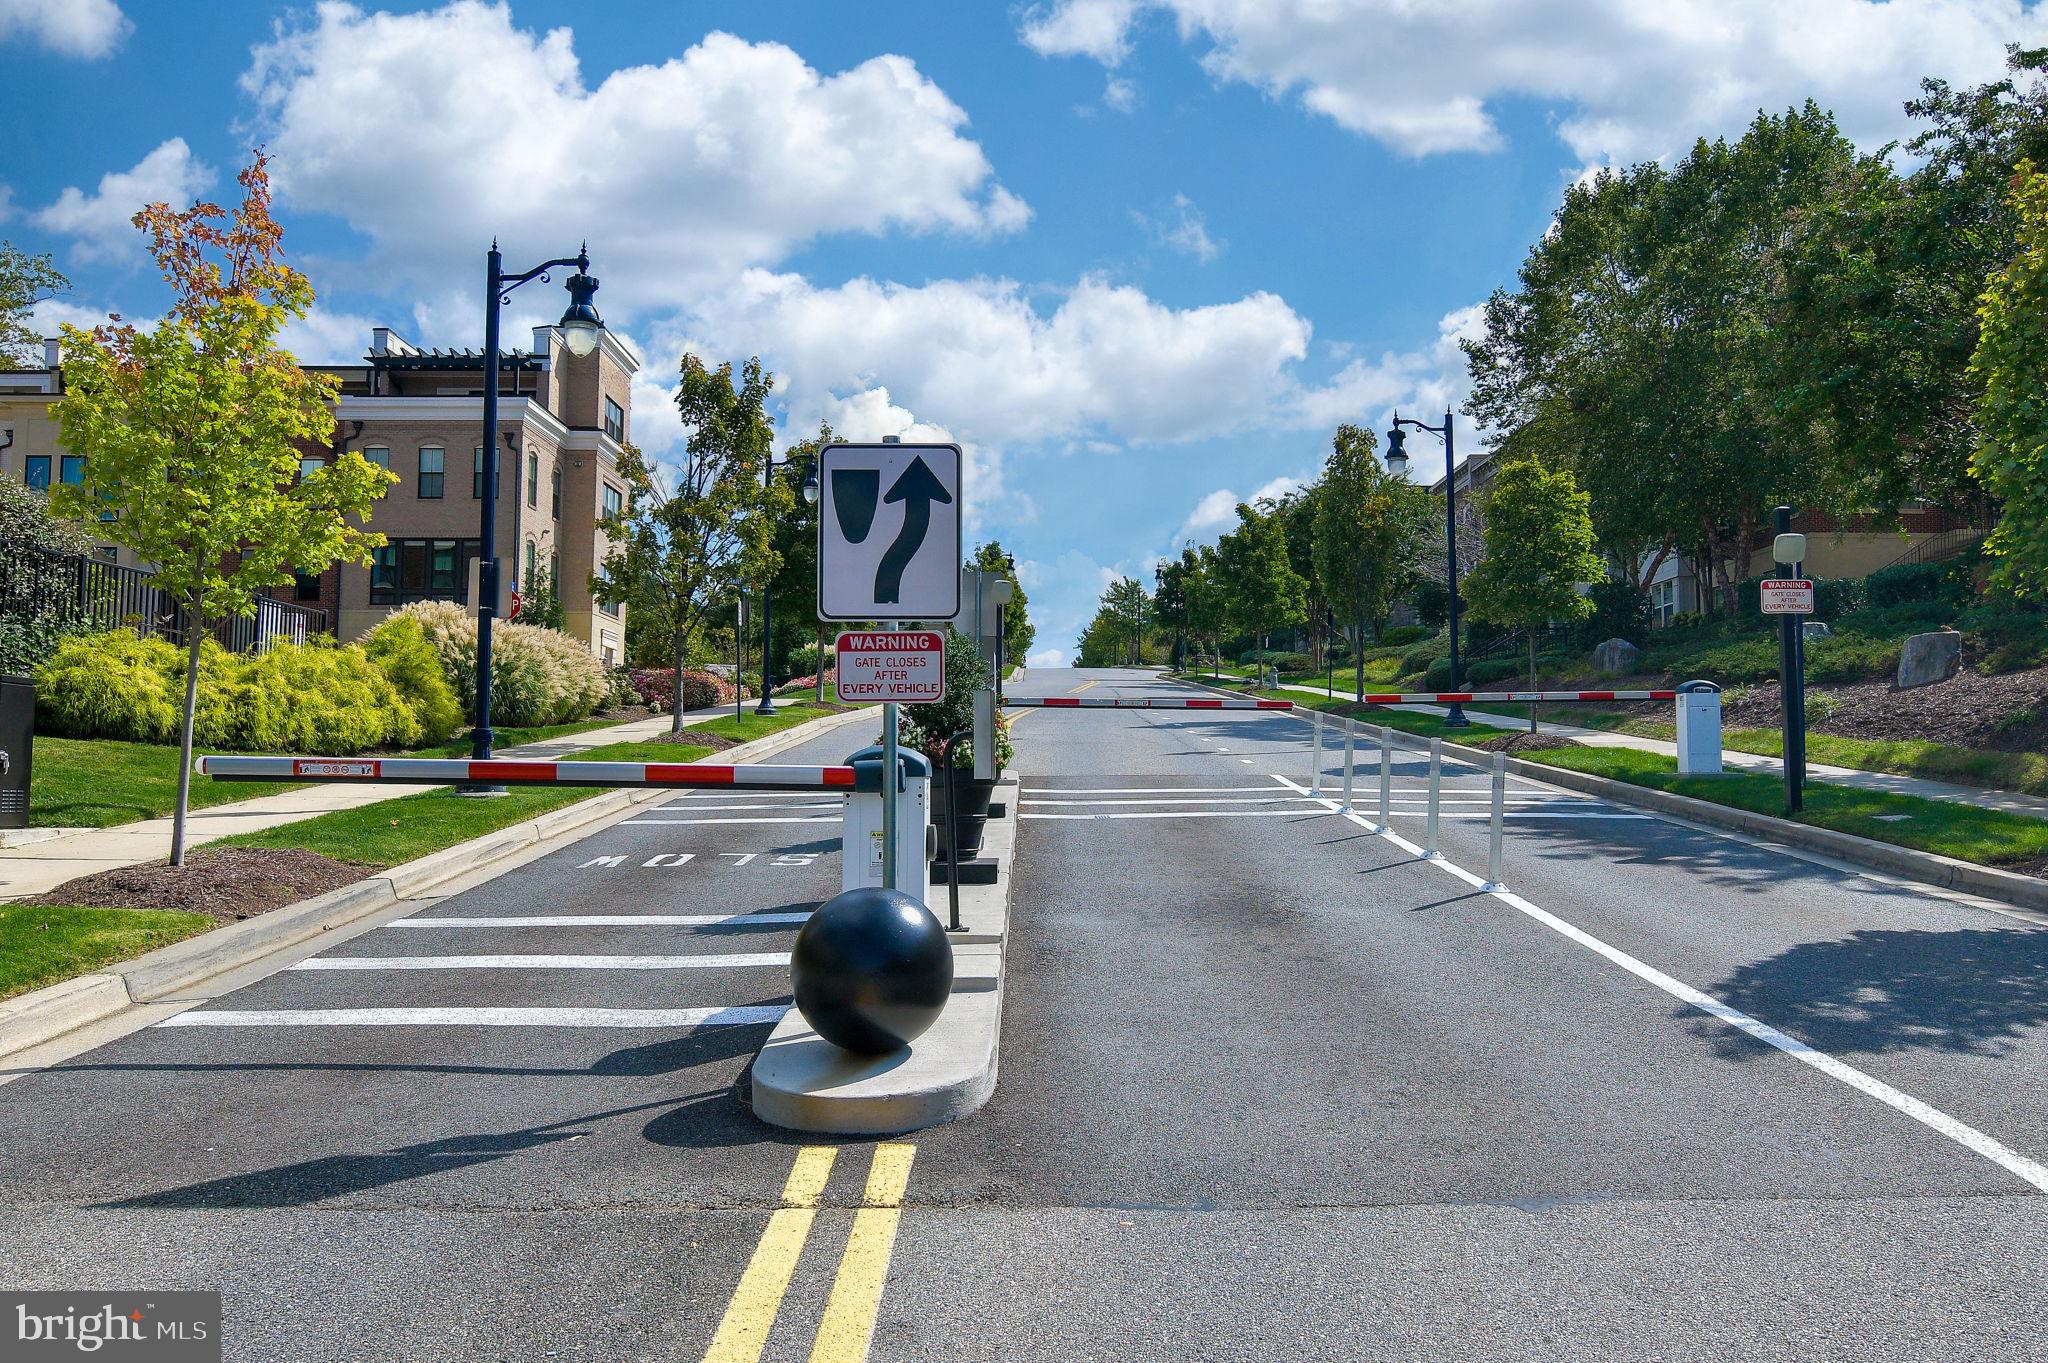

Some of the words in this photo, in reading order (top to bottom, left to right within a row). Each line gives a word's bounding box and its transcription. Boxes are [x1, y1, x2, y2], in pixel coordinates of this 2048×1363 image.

[849, 636, 930, 649] WARNING
[855, 657, 880, 667] GATE
[886, 657, 927, 667] CLOSES
[874, 670, 908, 680] AFTER
[843, 684, 883, 693] EVERY
[889, 683, 939, 693] VEHICLE
